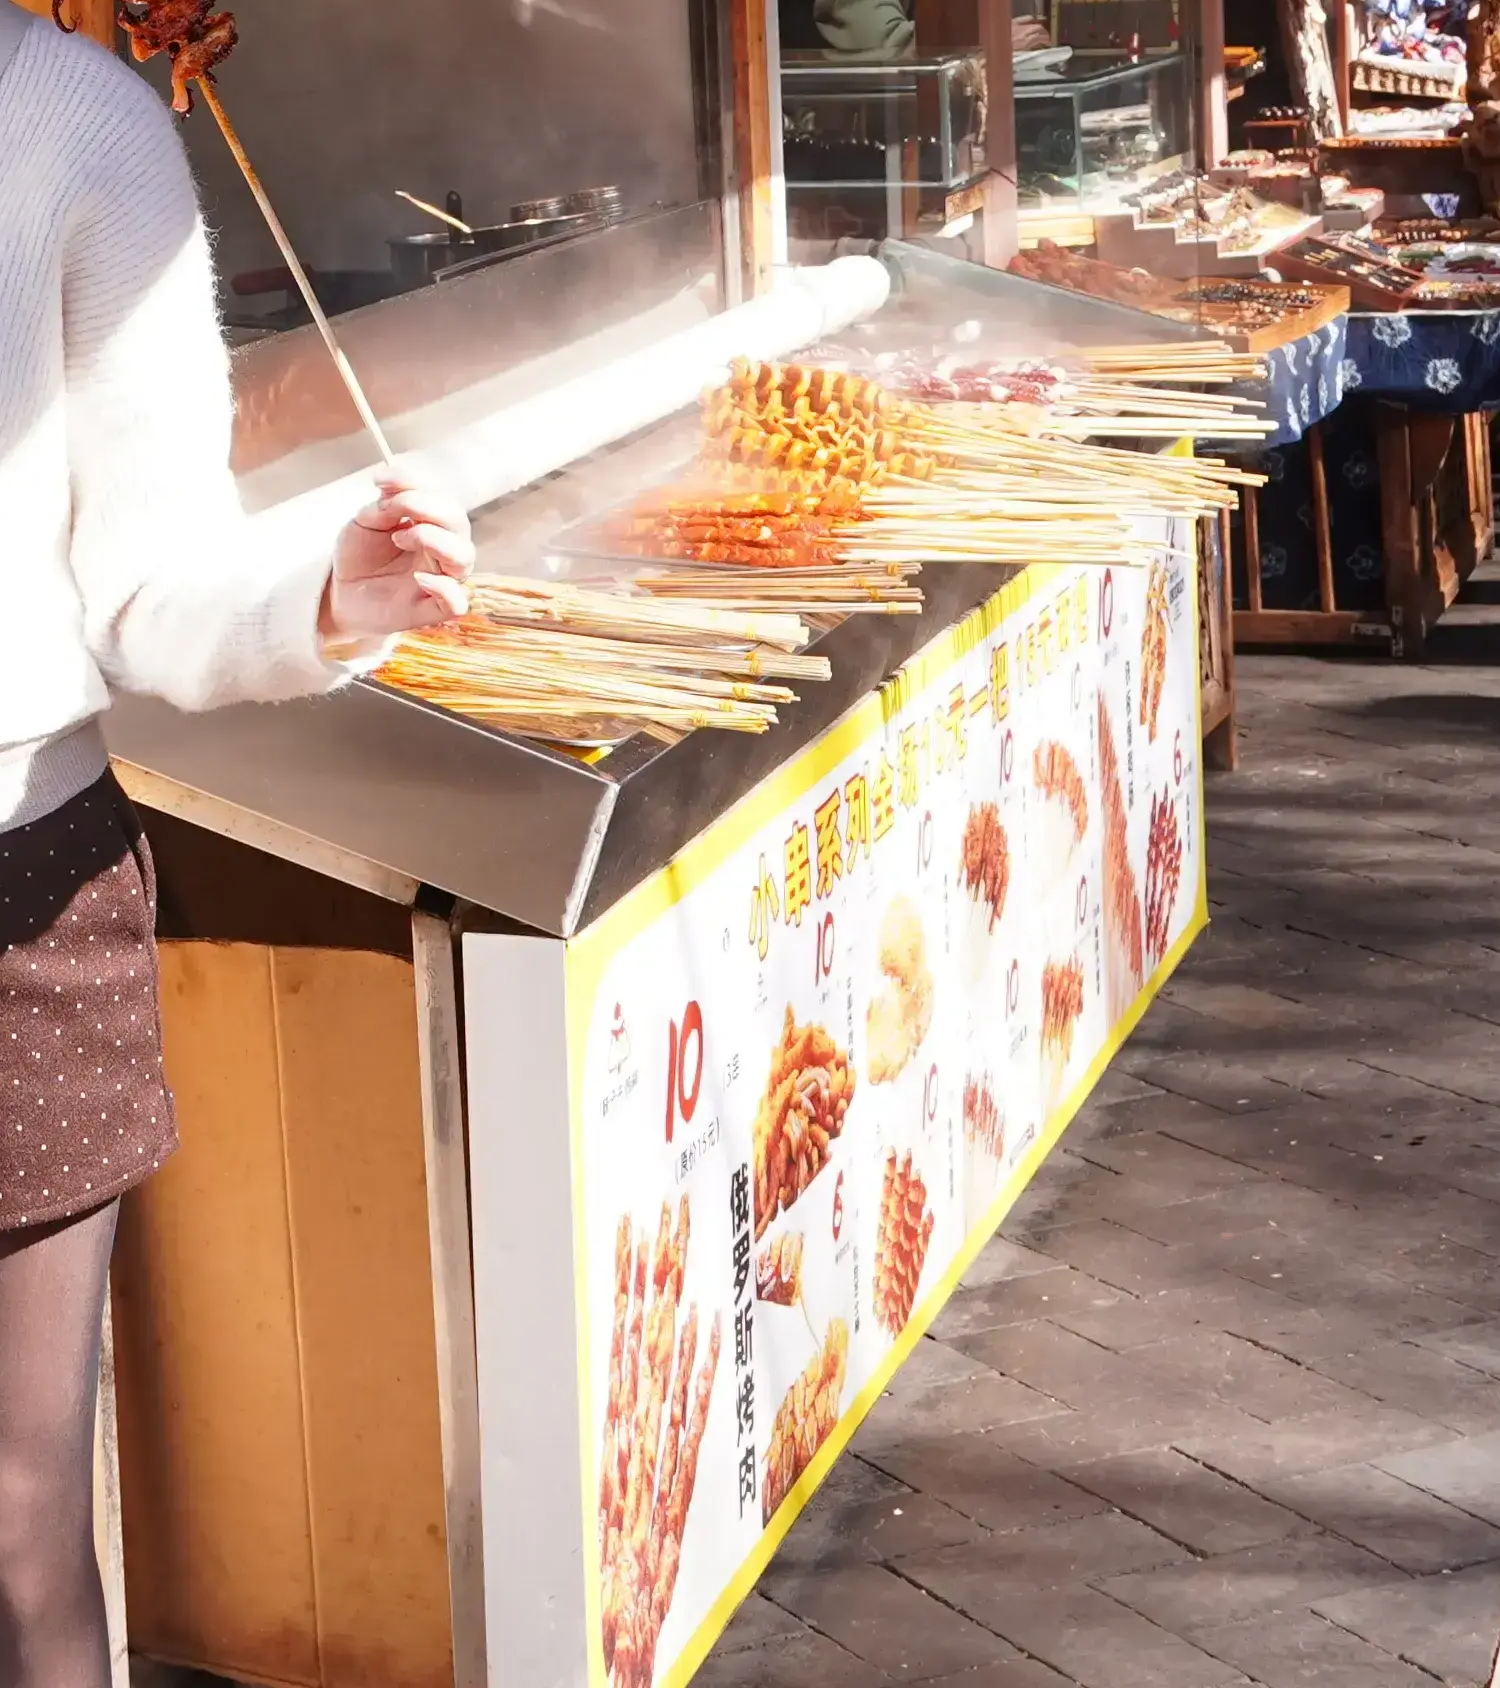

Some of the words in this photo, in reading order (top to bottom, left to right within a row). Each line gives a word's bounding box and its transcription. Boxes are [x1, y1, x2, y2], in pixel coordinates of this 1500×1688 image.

[665, 1000, 703, 1144] 10
[730, 1161, 757, 1519] 俄罗斯烤肉
